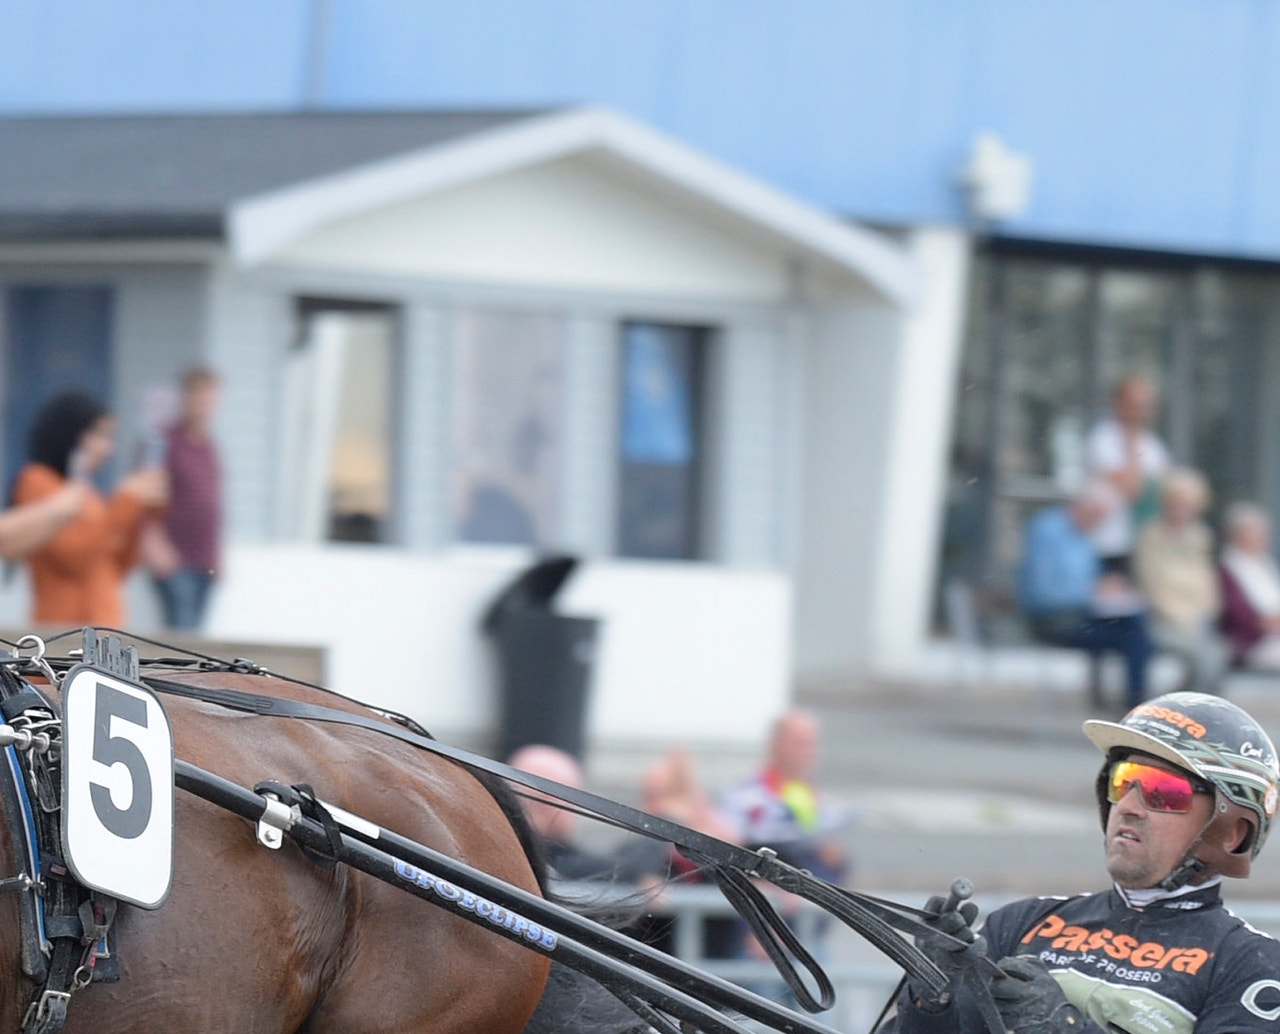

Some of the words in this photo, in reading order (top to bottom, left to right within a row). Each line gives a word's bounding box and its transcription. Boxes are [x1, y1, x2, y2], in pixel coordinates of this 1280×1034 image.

[89, 681, 153, 840] 5
[1021, 915, 1209, 976] Passera
[1095, 958, 1162, 983] PROSERO
